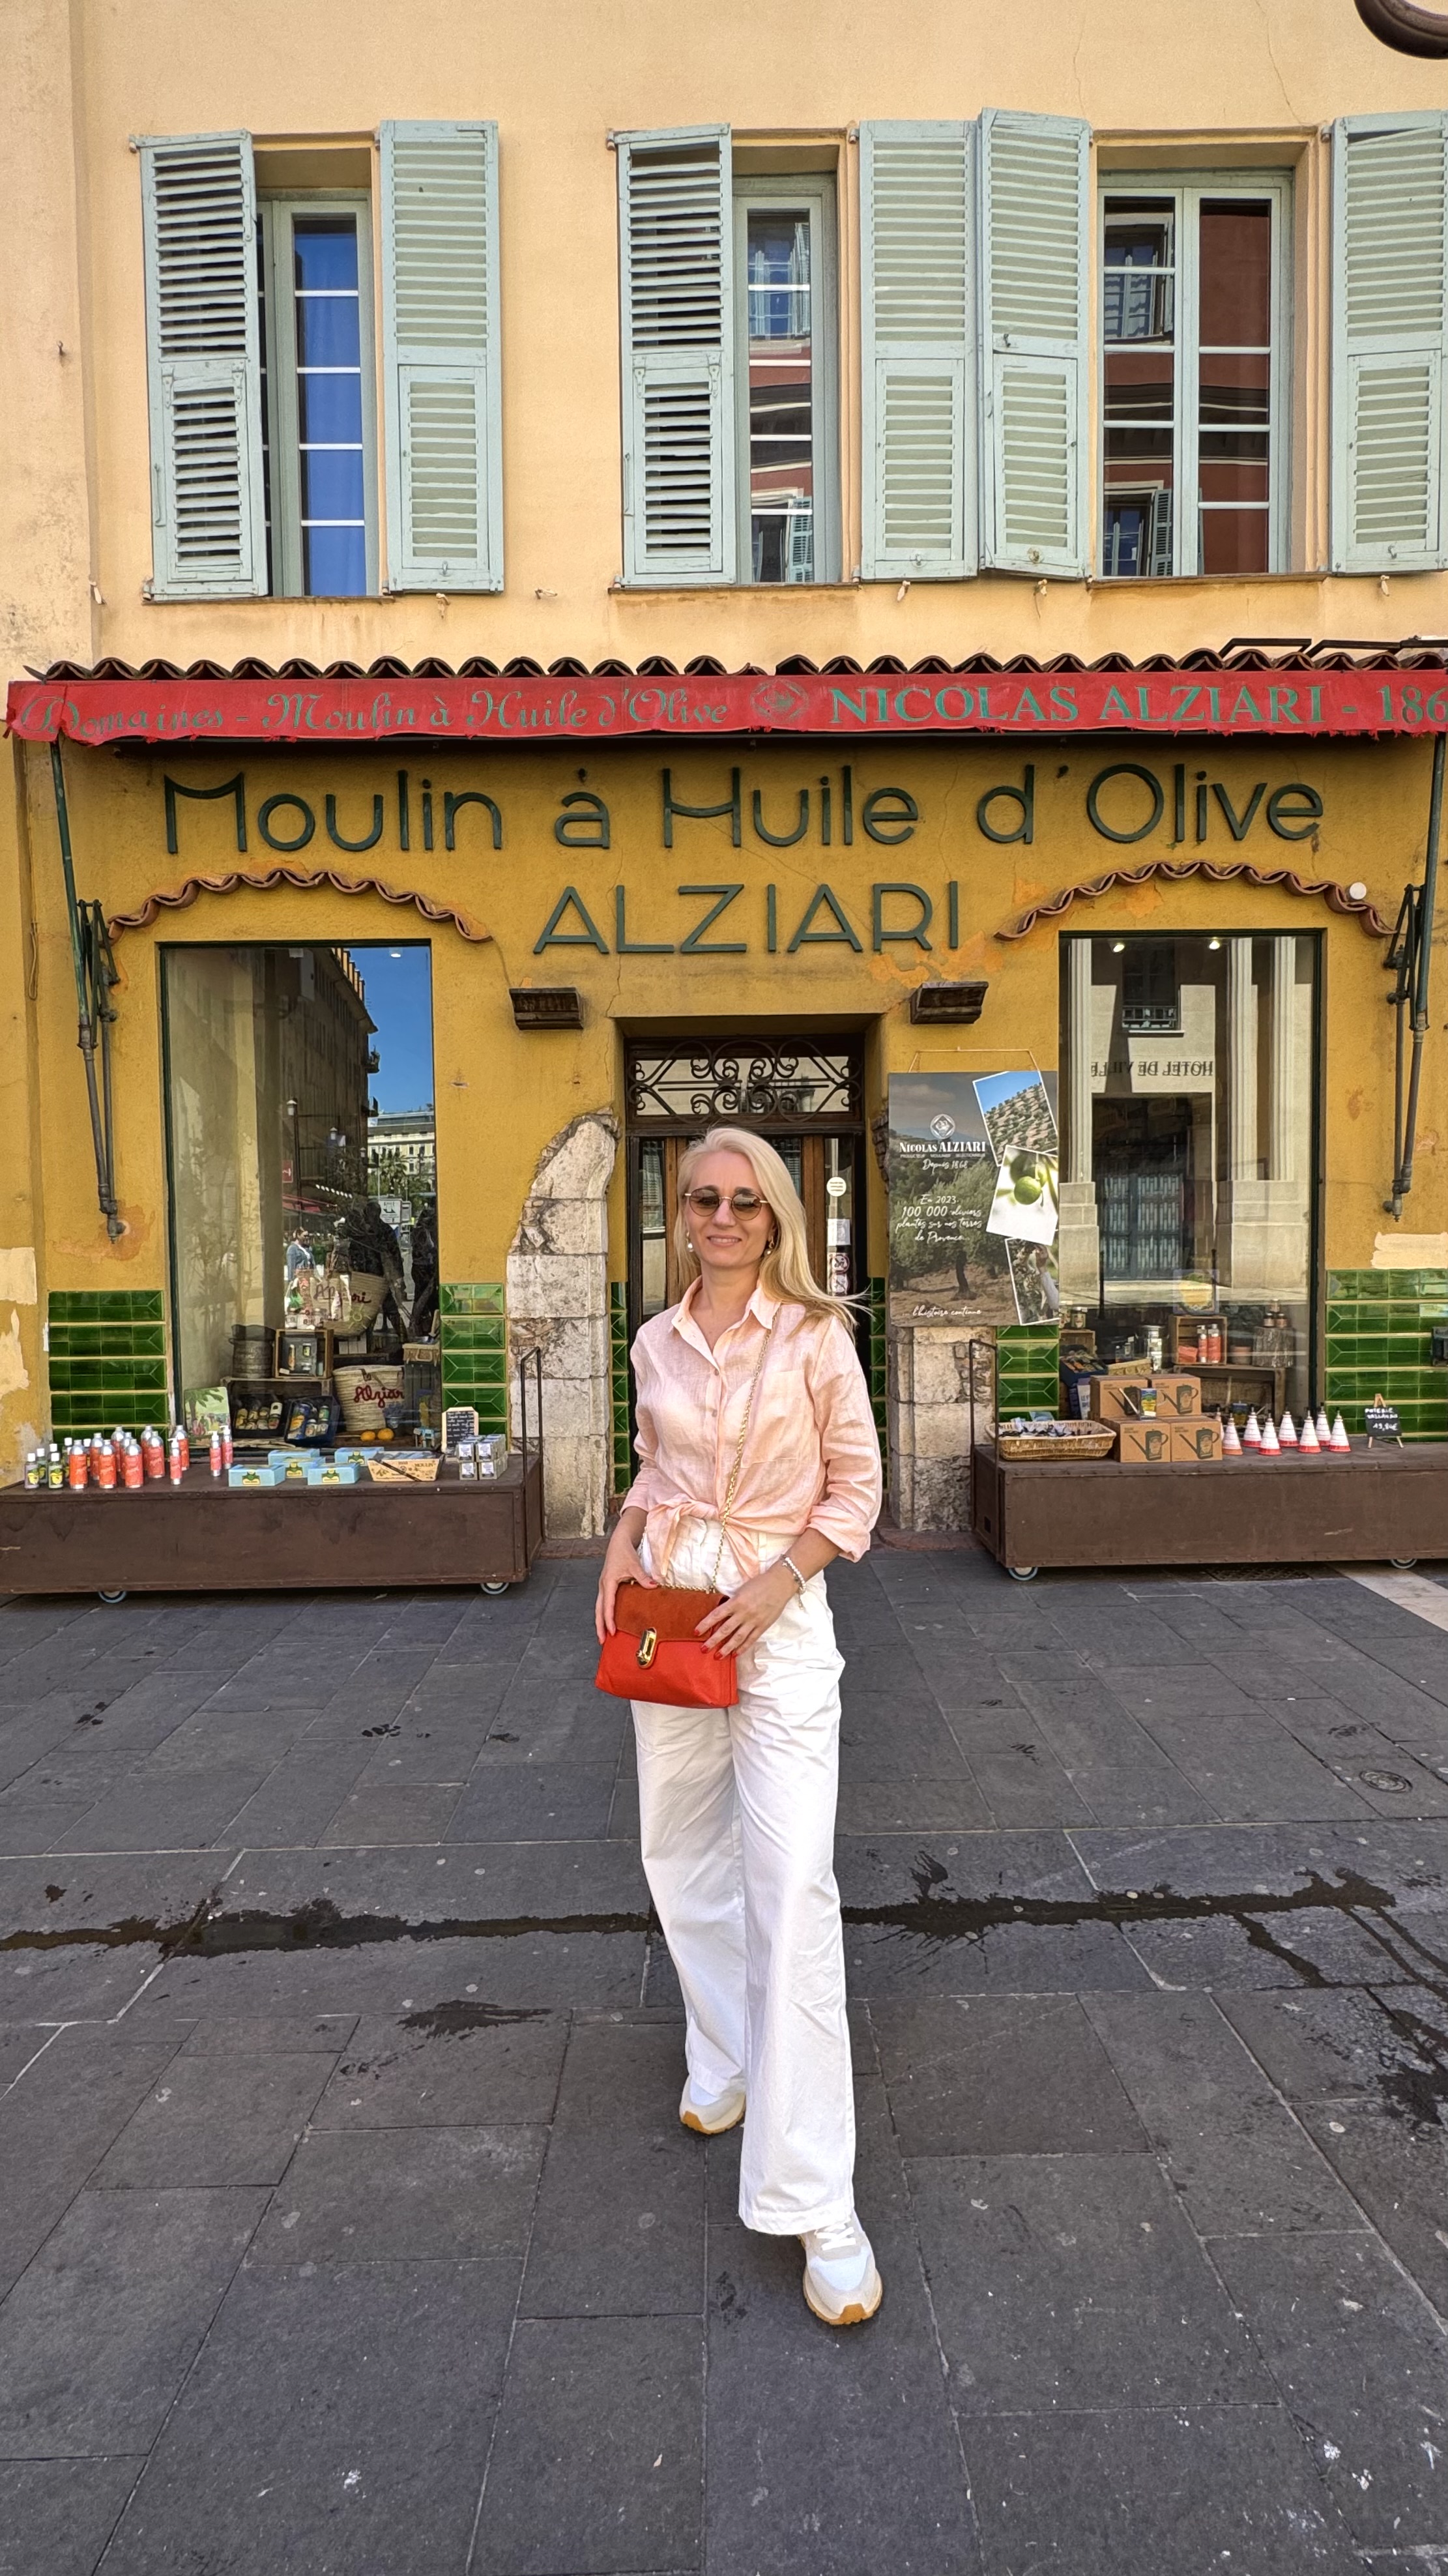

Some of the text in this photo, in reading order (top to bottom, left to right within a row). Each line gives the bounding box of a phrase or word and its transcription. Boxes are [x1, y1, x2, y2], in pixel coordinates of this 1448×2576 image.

[21, 695, 223, 737] Domaines
[263, 693, 418, 729] Moulin
[429, 695, 454, 726] à
[467, 690, 586, 728] Huile
[598, 688, 728, 726] d'Olive
[829, 686, 1079, 724] NICOLAS
[1100, 686, 1325, 724] ALZIARI
[164, 763, 1324, 855] Moulin à Huile d'Olive
[533, 881, 958, 954] ALZIARI
[899, 1141, 986, 1152] NICOLAS ALZIARI
[922, 1158, 969, 1175] Depuis 1868
[919, 1194, 933, 1205] En
[901, 1207, 921, 1218] 100
[926, 1206, 948, 1217] 000
[914, 1229, 925, 1241] de
